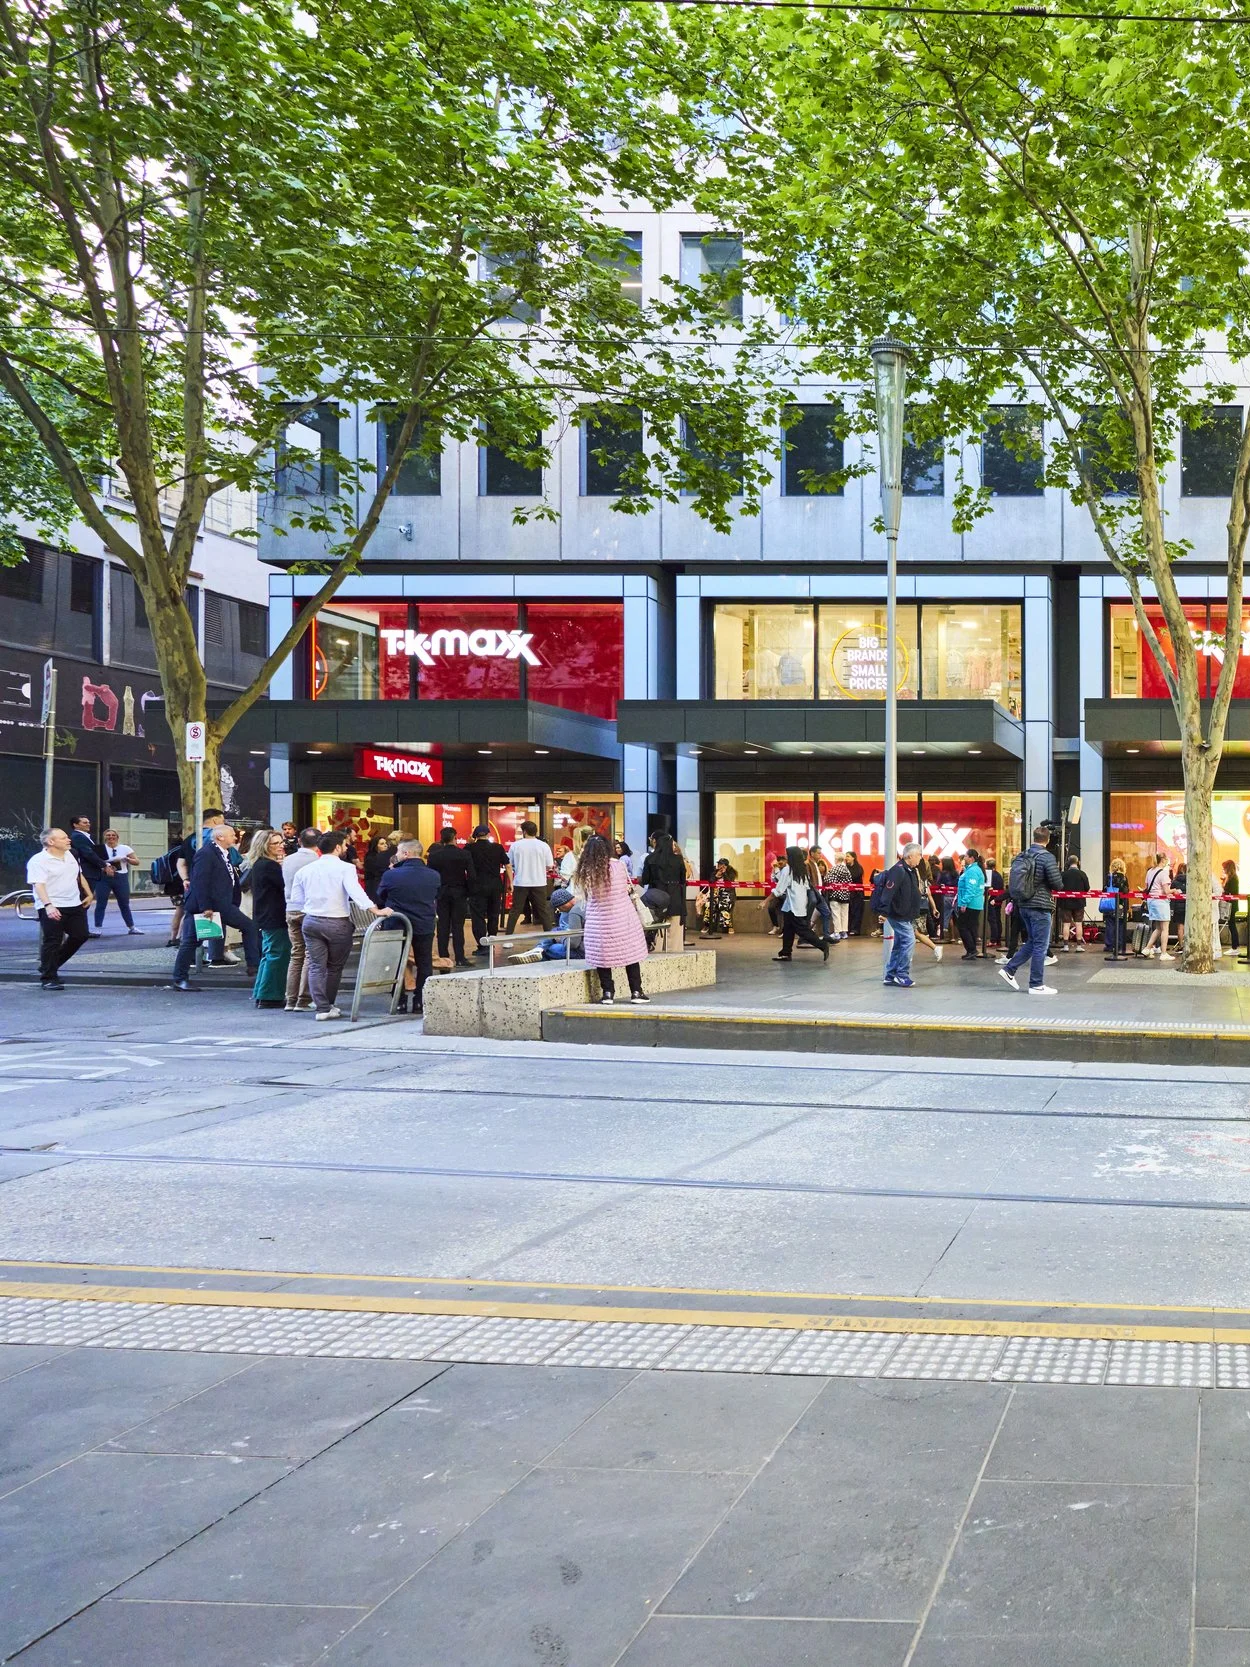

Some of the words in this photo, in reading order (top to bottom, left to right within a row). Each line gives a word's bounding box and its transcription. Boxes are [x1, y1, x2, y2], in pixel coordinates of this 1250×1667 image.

[859, 636, 879, 648] BIG
[851, 665, 887, 677] SMALL
[849, 678, 887, 690] PRICES
